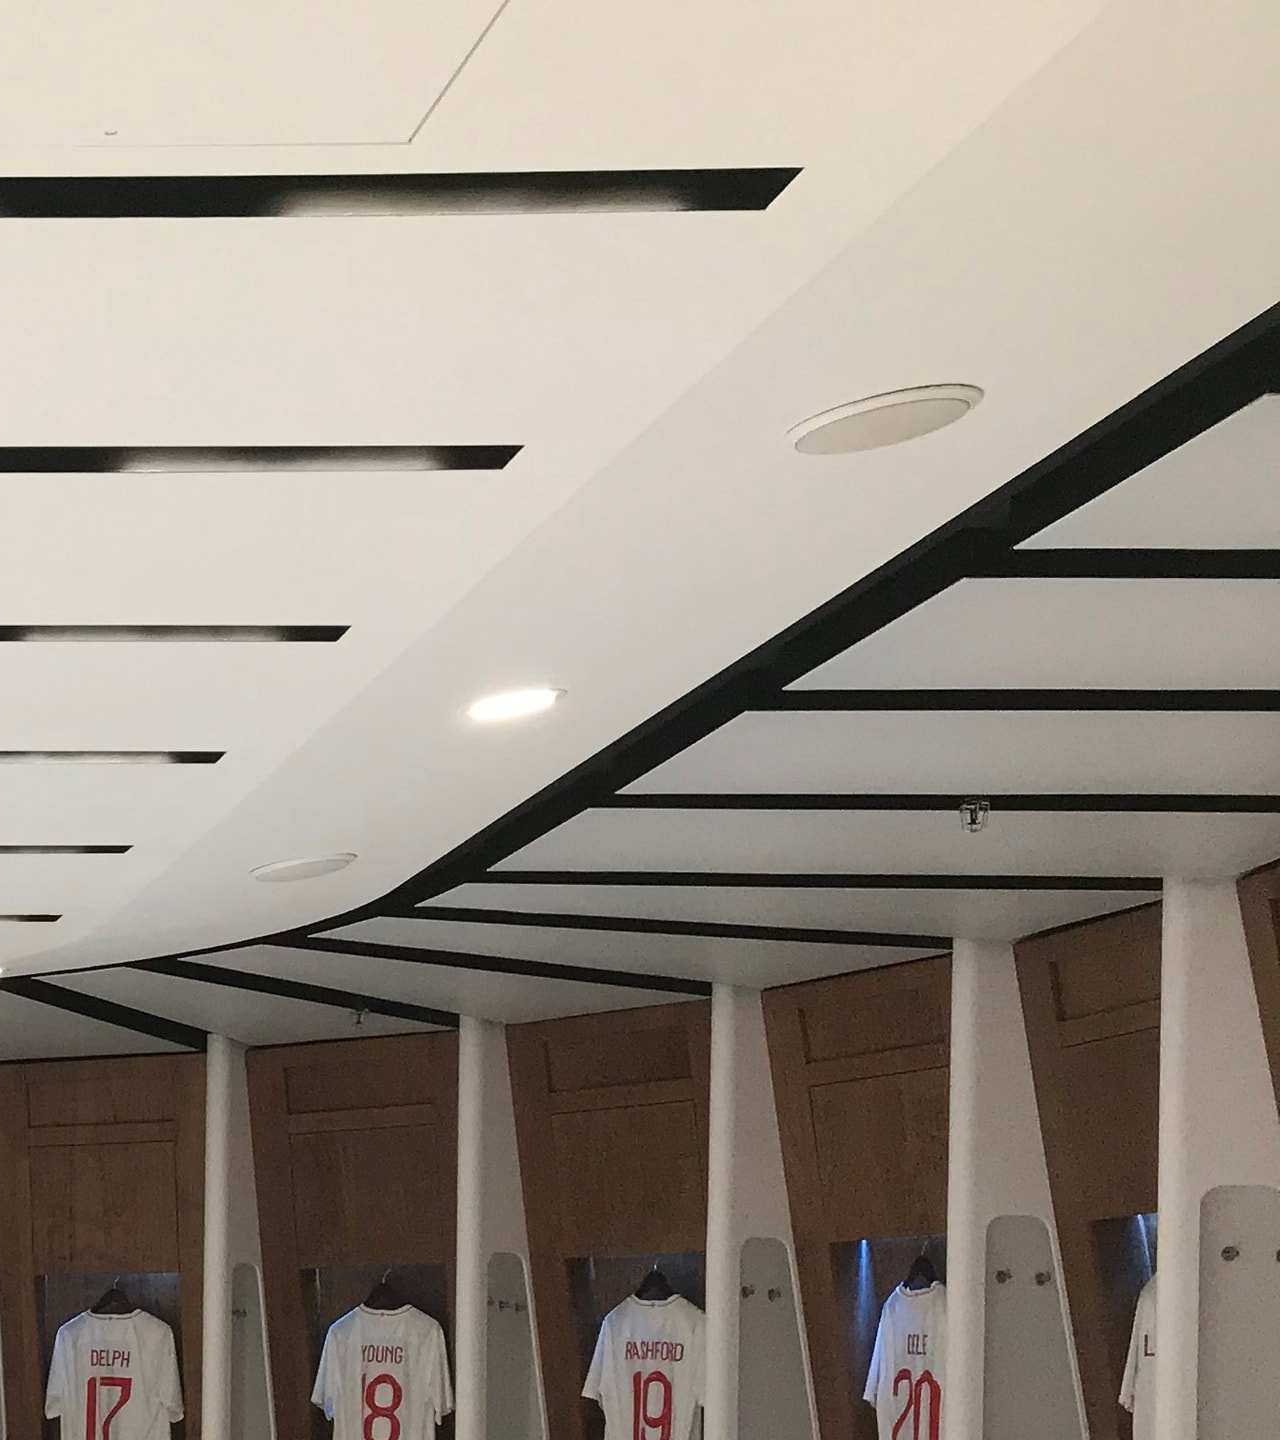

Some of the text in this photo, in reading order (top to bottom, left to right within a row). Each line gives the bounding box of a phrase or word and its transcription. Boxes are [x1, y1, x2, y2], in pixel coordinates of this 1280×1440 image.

[90, 1349, 131, 1368] DELPH
[361, 1344, 404, 1364] YOUNG
[625, 1341, 684, 1362] RASHFORD
